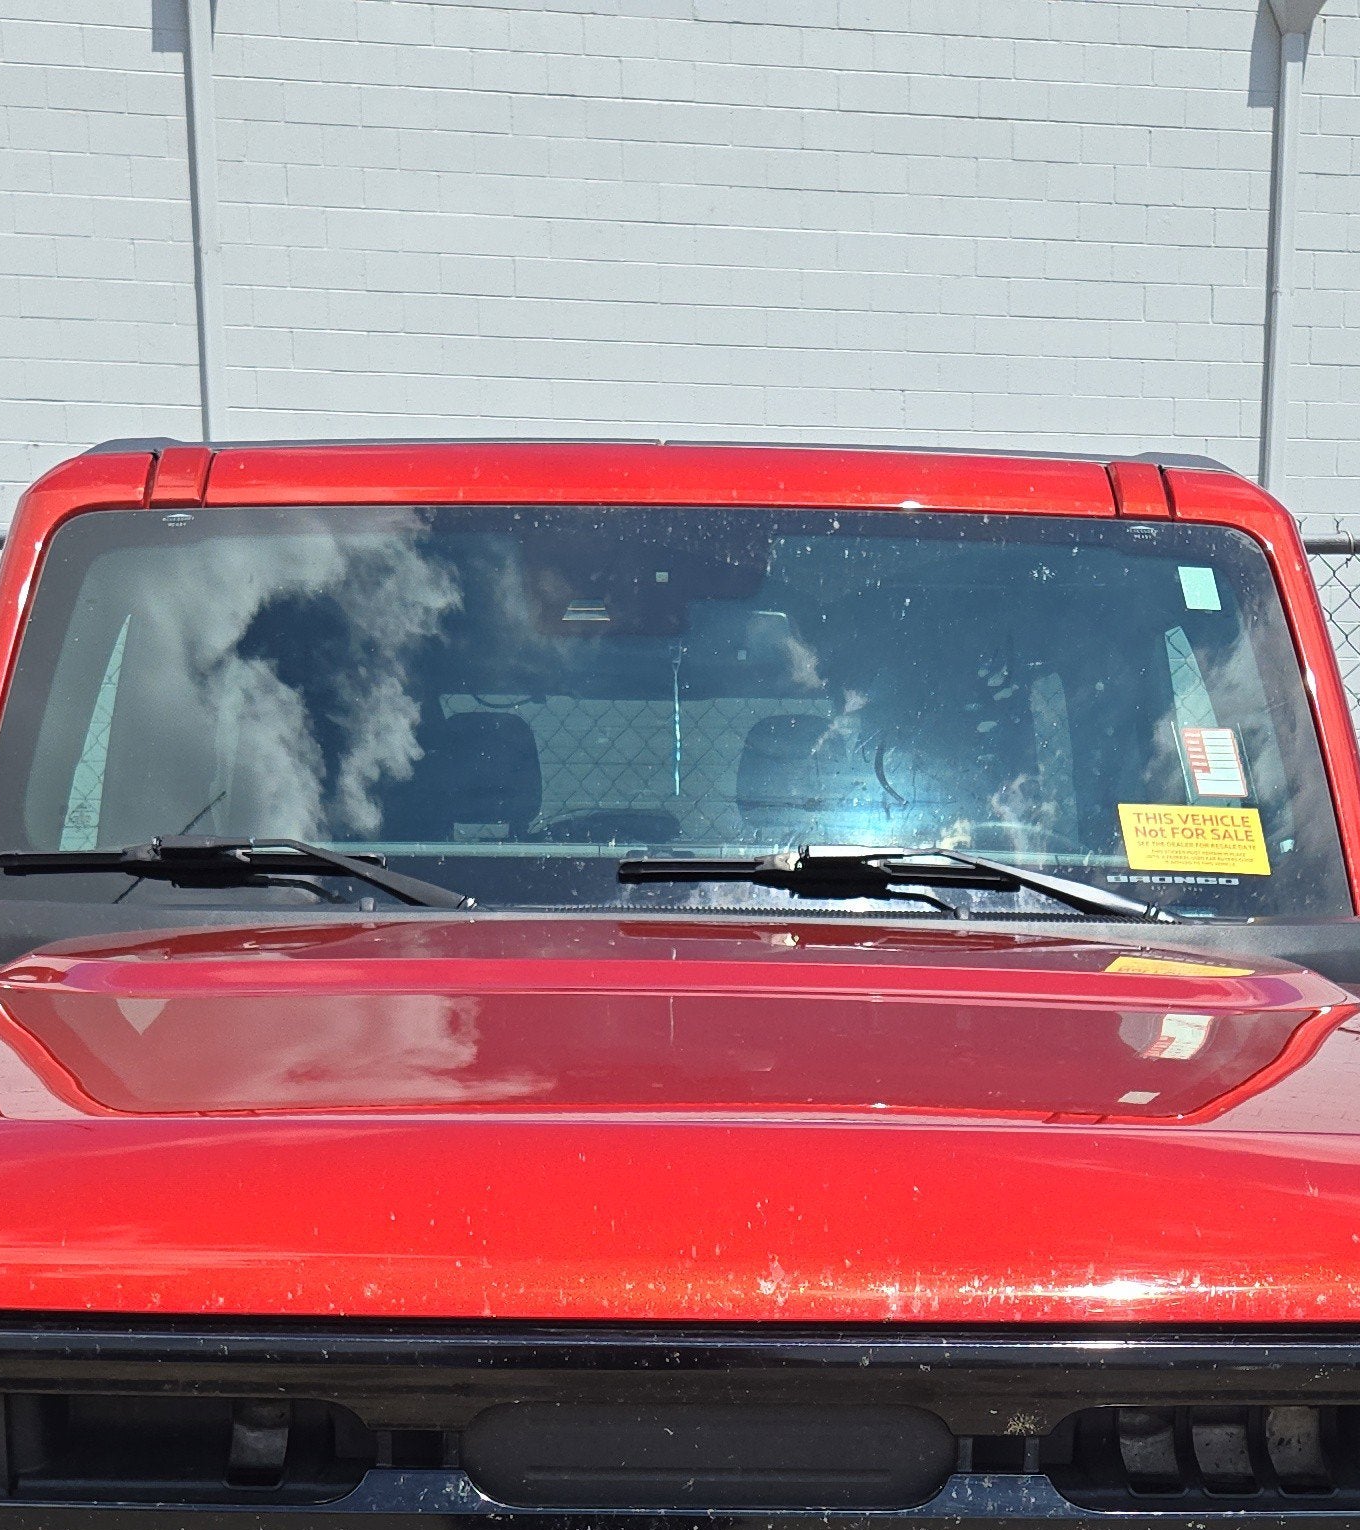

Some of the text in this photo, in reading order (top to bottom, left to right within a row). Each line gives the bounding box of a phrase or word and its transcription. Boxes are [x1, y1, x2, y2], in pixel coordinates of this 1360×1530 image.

[1132, 812, 1251, 828] THIS VEHICLE
[1134, 826, 1255, 842] Not FOR SALE
